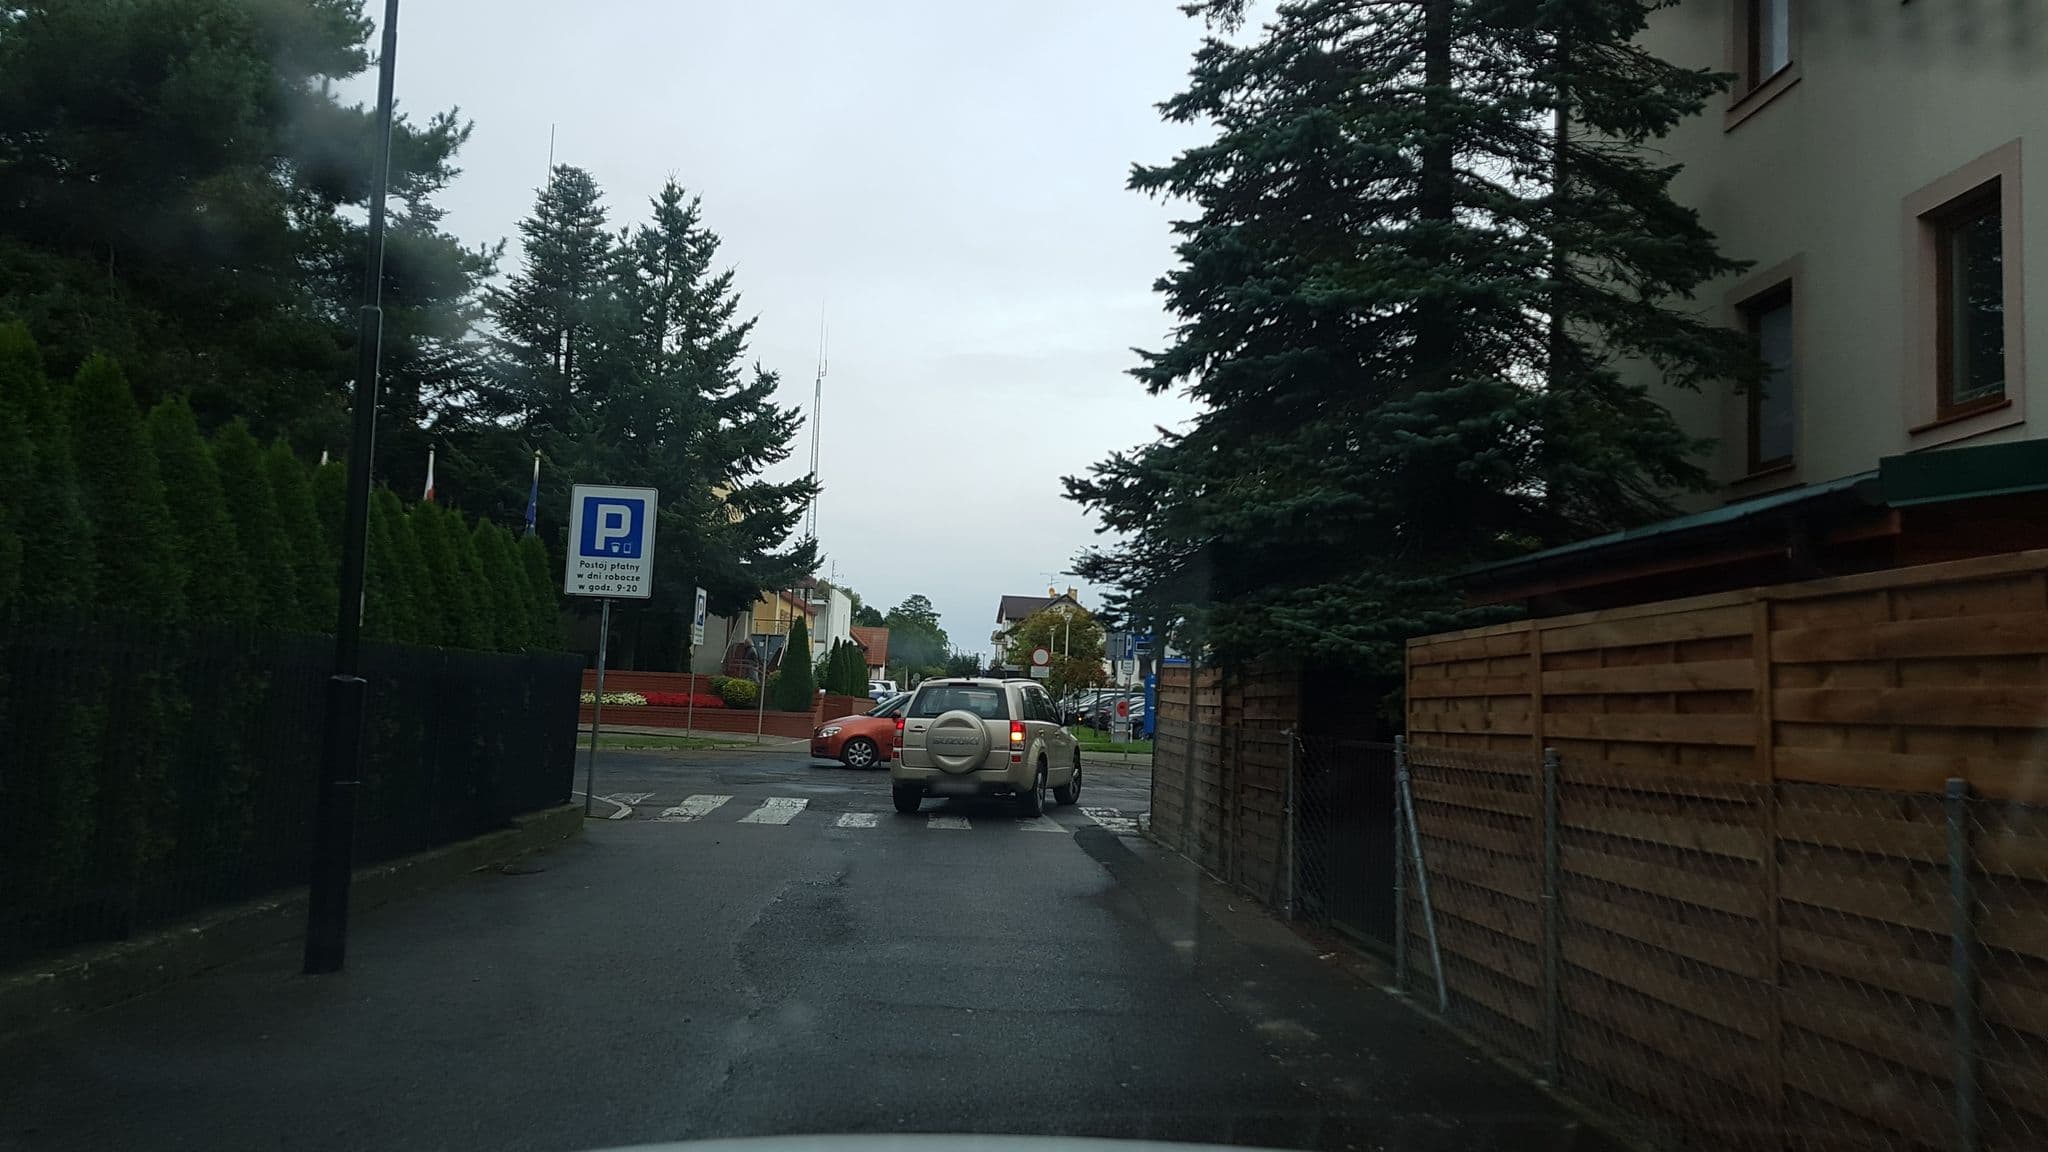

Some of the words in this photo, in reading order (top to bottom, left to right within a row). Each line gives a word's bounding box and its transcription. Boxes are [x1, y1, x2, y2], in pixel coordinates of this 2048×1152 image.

[594, 503, 632, 551] P
[586, 572, 602, 580] dni
[604, 573, 641, 582] robocze
[588, 583, 613, 592] godz.
[616, 584, 638, 592] 9-20
[1125, 634, 1132, 656] P
[933, 735, 979, 746] SUZUKI
